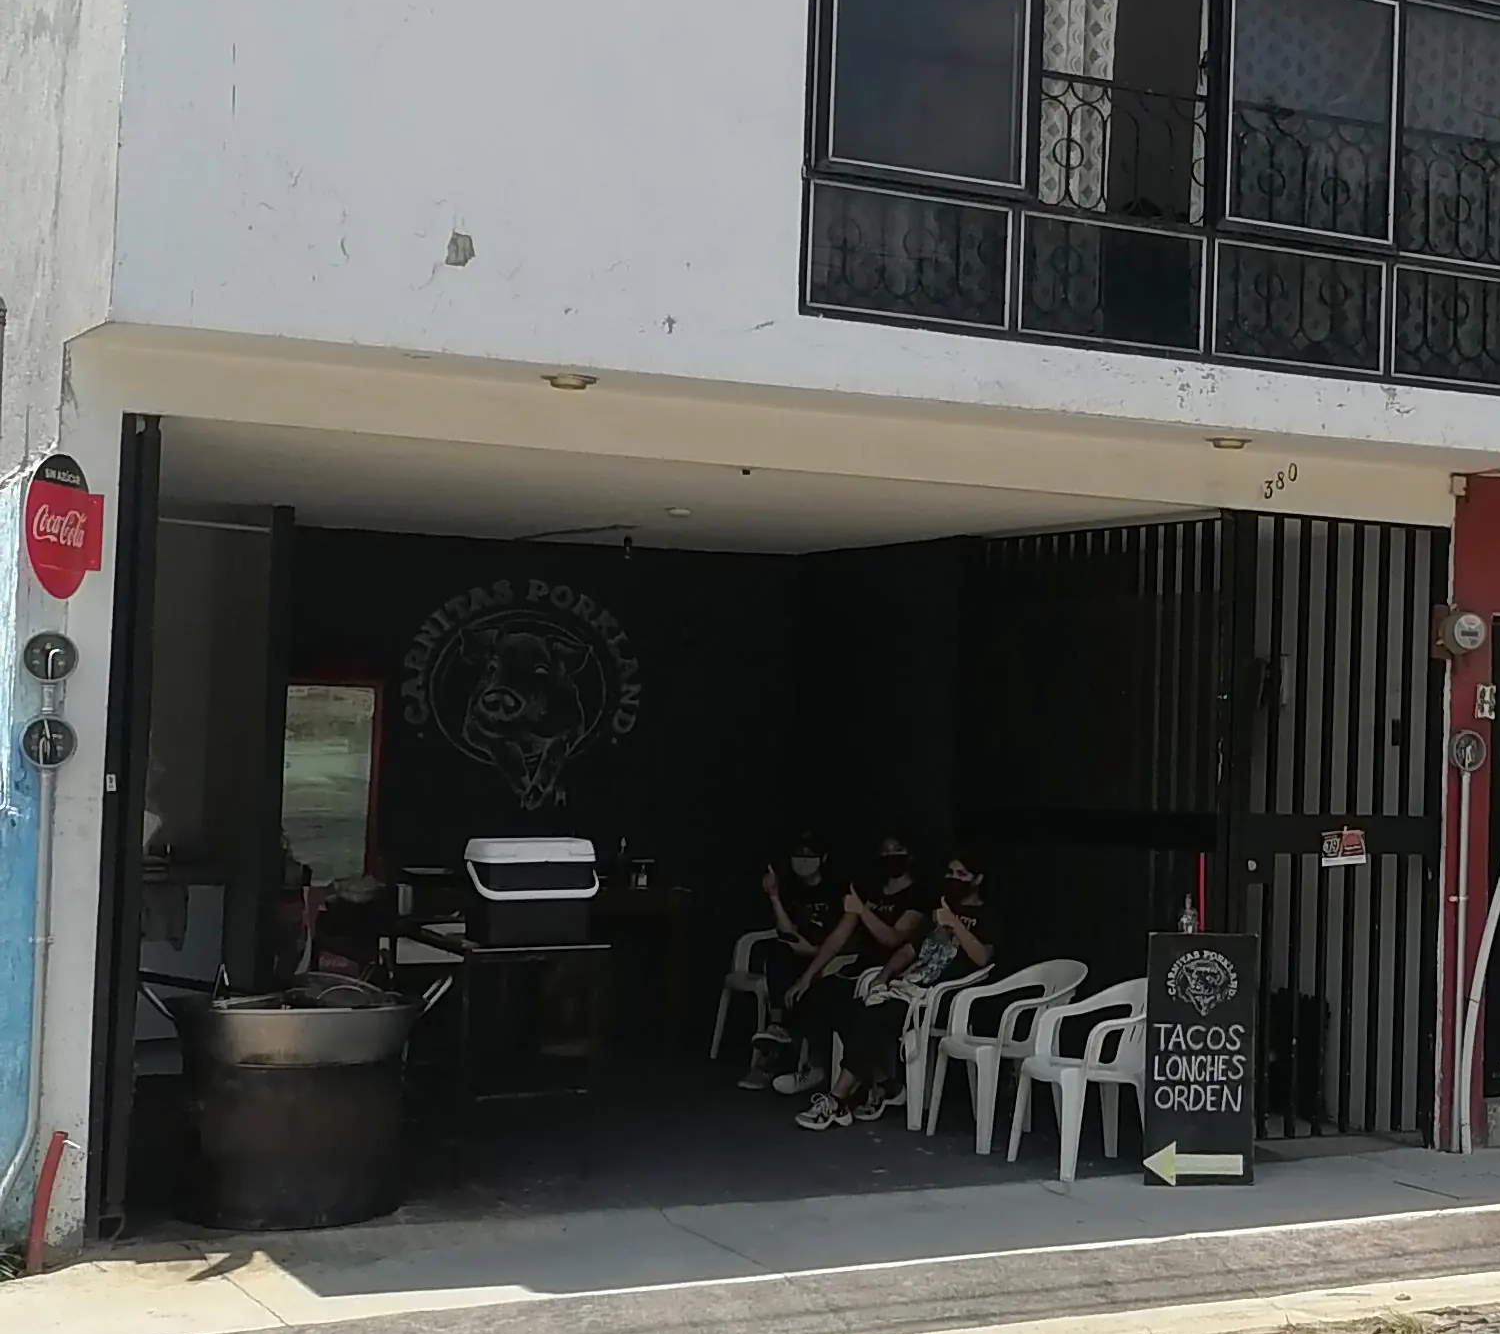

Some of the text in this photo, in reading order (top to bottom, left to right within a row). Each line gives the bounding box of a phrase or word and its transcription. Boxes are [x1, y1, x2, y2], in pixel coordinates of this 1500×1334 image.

[1264, 462, 1298, 499] 380
[401, 579, 642, 734] CARNITAS PORKLAND
[1153, 1023, 1247, 1052] TACOS
[1153, 1054, 1248, 1084] LONCHES
[1154, 1084, 1243, 1113] ORDEN
